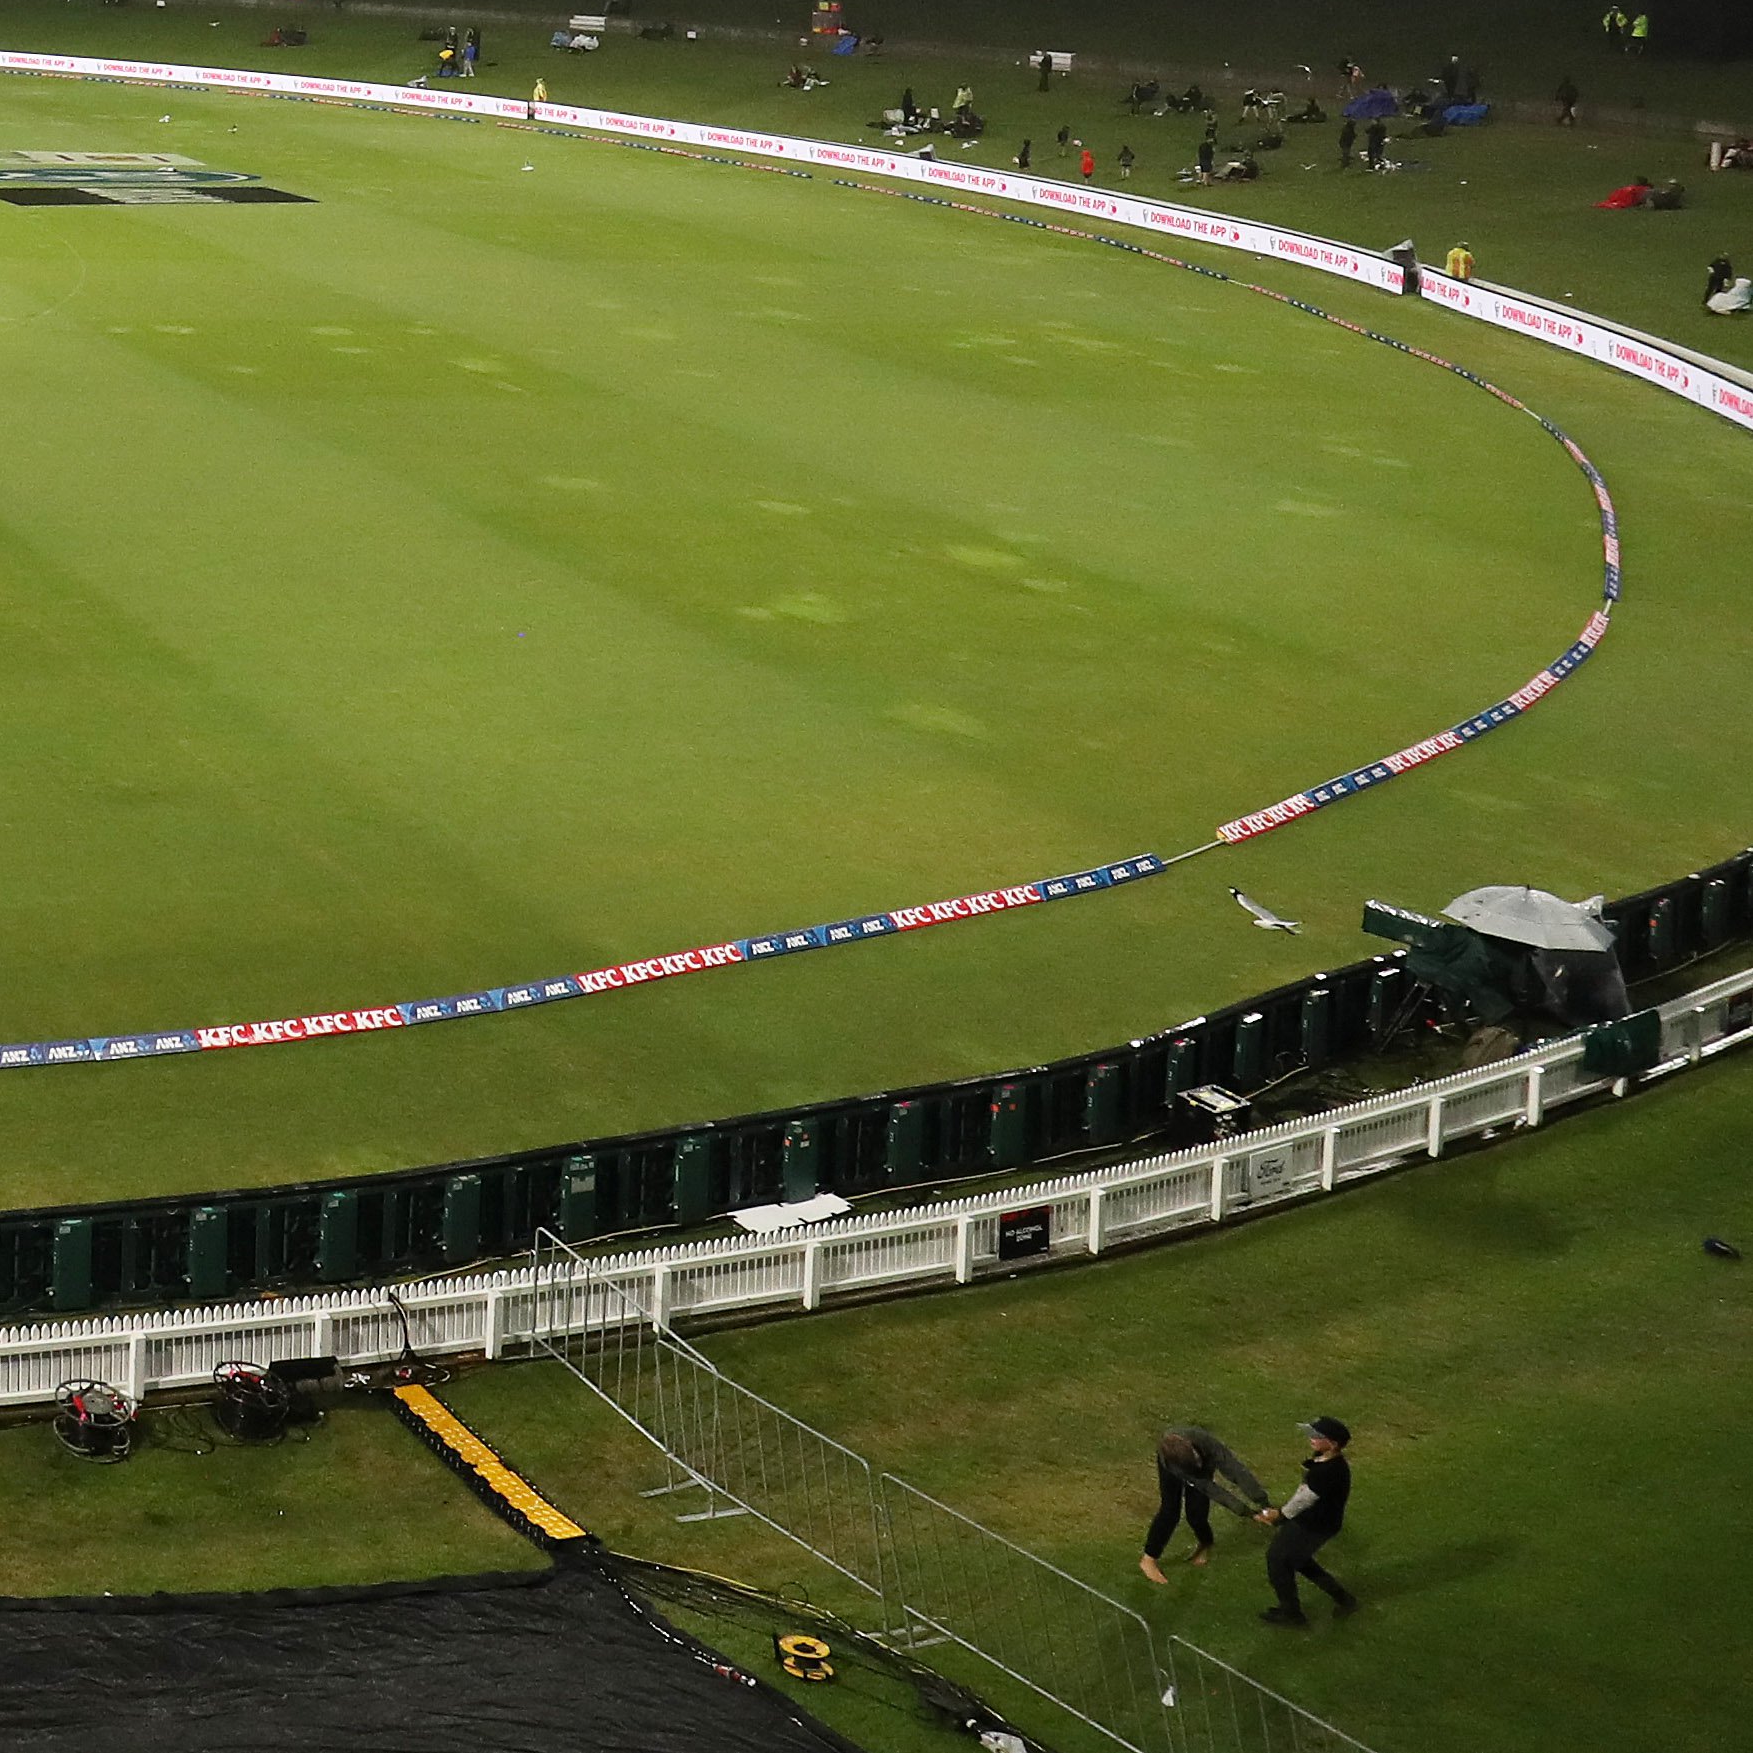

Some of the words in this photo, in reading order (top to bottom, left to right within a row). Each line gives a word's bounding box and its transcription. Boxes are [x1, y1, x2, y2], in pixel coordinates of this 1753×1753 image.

[929, 167, 965, 183] DOWNLOAD
[969, 175, 979, 186] THE
[981, 177, 995, 187] APP
[1040, 188, 1076, 205] DOWNLOAD
[1080, 194, 1090, 208] THE
[1092, 199, 1105, 210] APP
[1279, 240, 1318, 260] DOWNLOAD
[1320, 250, 1332, 265] THE
[1335, 254, 1348, 265] APP
[1502, 305, 1541, 330] DOWNLOAD
[1543, 317, 1556, 335] THE
[1558, 324, 1572, 338] APP
[1615, 343, 1653, 371] DOWNLOAD
[1654, 359, 1665, 377] THE
[1667, 366, 1679, 380] APP
[1219, 821, 1250, 840] KFC
[1242, 812, 1273, 832] KFC
[1262, 803, 1294, 823] KFC
[1284, 794, 1314, 814] KFC
[889, 907, 931, 927] KFC
[927, 900, 968, 920] KFC
[964, 893, 1004, 914] KFC
[1000, 886, 1040, 906] KFC
[578, 969, 623, 992] KFC
[620, 960, 663, 983] KFC
[657, 952, 701, 974] KFC
[700, 945, 742, 968] KFC
[417, 1006, 442, 1019] ANZ
[457, 997, 484, 1012] ANZ
[507, 989, 532, 1005] ANZ
[545, 983, 569, 996] ANZ
[199, 1026, 250, 1048] KFC
[250, 1020, 302, 1042] KFC
[302, 1014, 351, 1034] KFC
[352, 1009, 402, 1029] KFC
[1, 1050, 30, 1064] ANZ
[49, 1045, 78, 1059] ANZ
[110, 1040, 137, 1055] ANZ
[156, 1037, 188, 1051] ANZ
